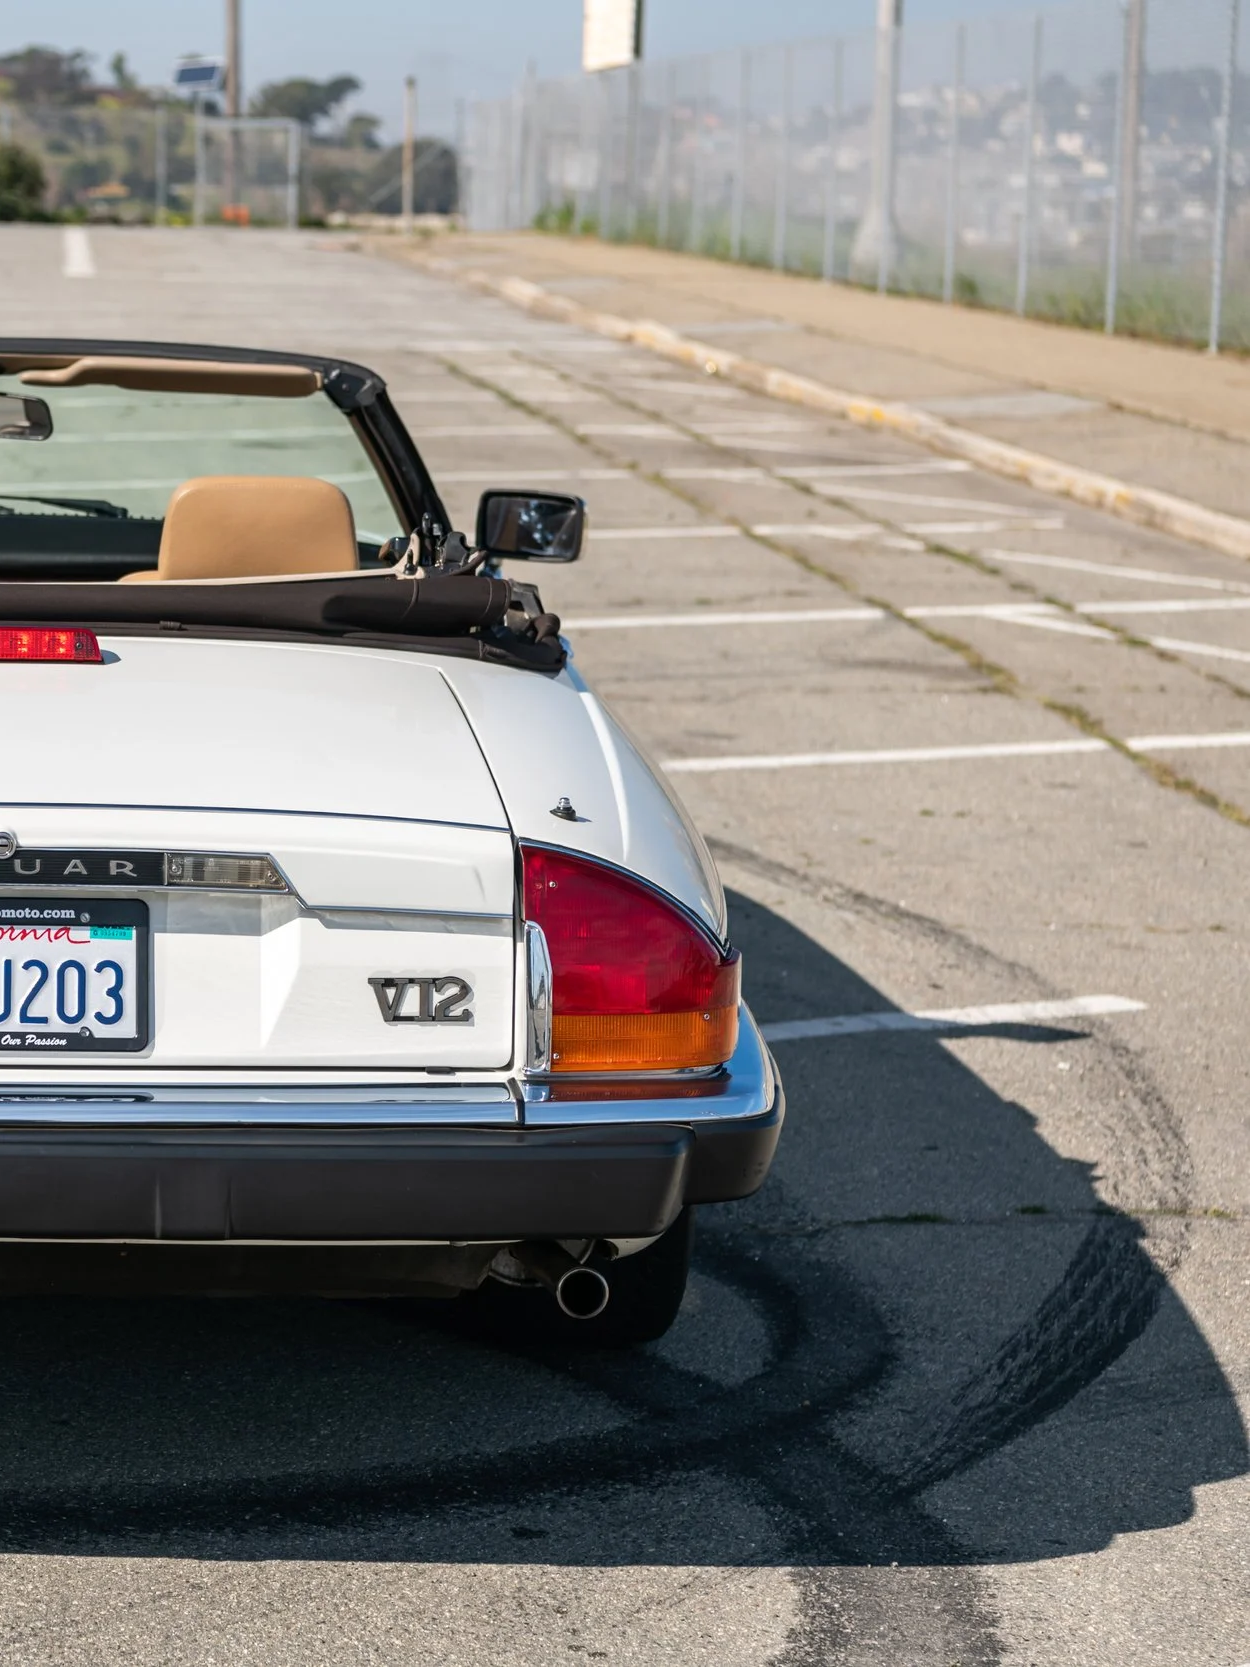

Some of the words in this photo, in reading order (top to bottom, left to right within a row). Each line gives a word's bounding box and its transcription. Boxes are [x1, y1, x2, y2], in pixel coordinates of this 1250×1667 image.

[367, 976, 474, 1023] V12
[0, 1034, 22, 1046] Our
[24, 1034, 68, 1046] Passion
